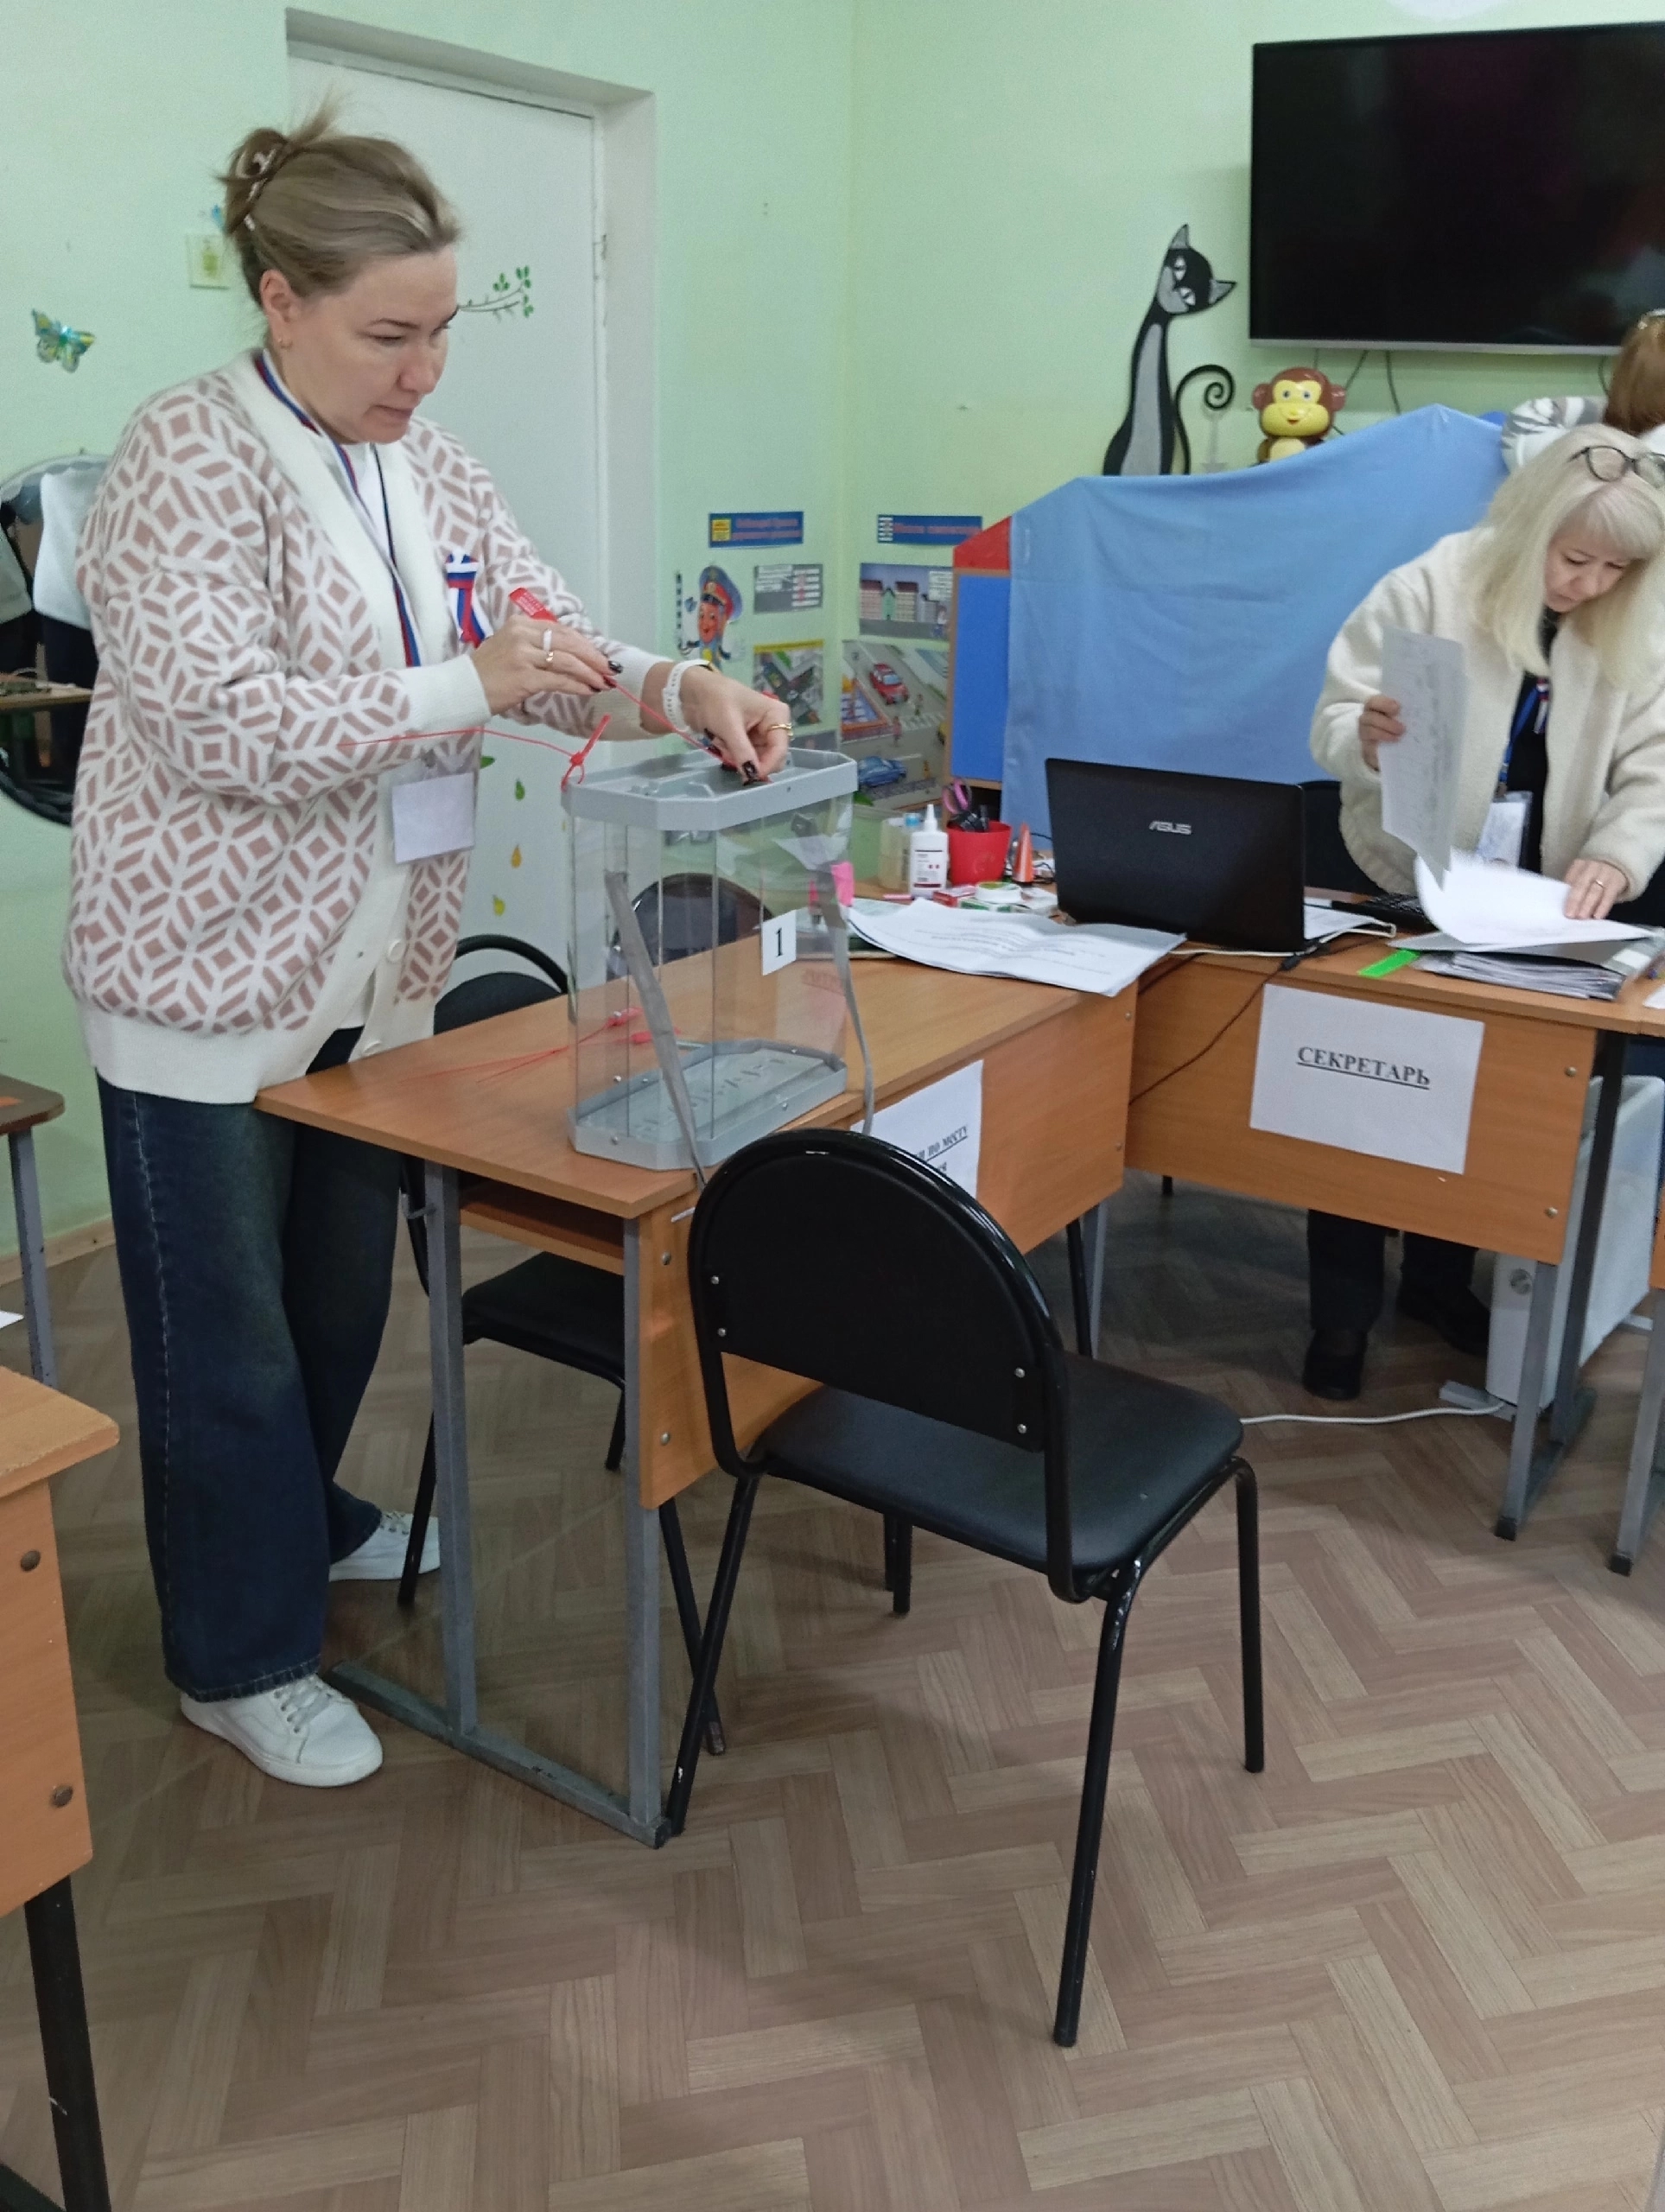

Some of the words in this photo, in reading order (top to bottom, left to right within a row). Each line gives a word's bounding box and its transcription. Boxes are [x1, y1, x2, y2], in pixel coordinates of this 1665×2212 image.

[1149, 821, 1192, 836] ASUS
[775, 926, 784, 958] 1
[1297, 1046, 1431, 1086] СЕКРЕТАРЬ
